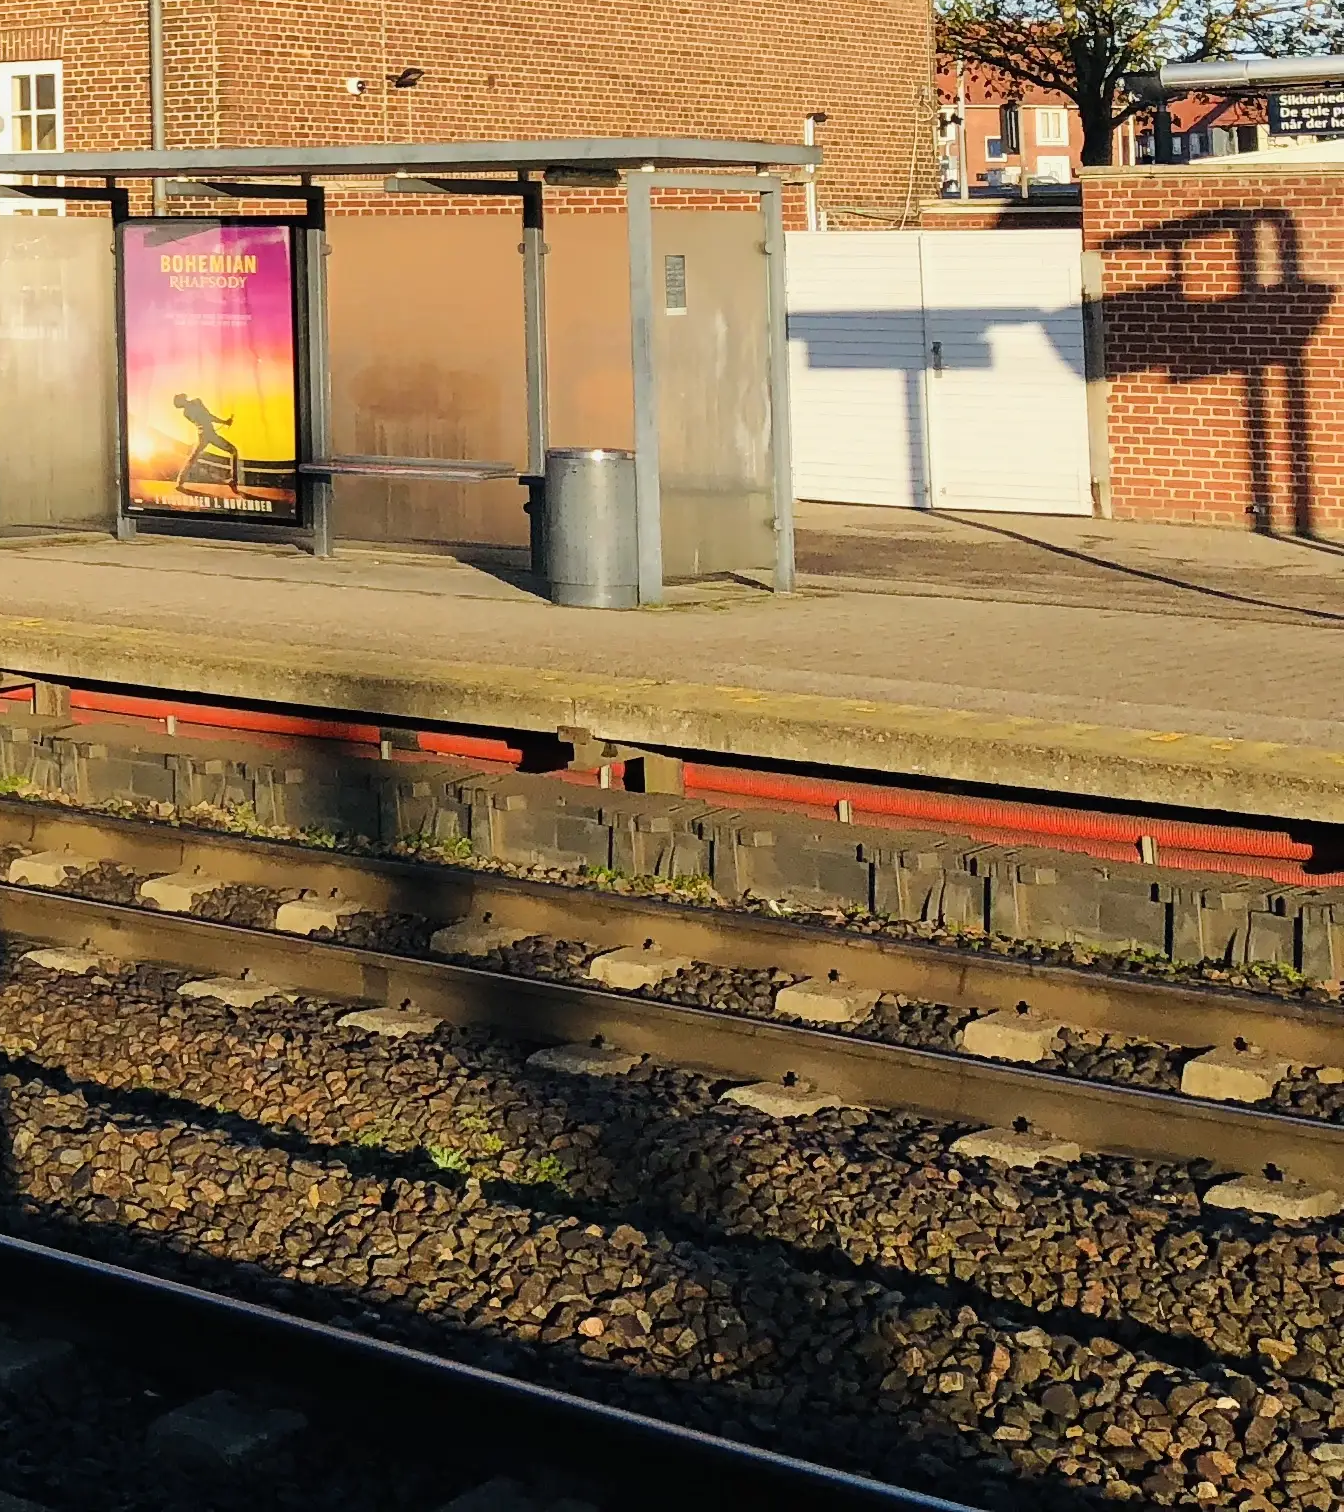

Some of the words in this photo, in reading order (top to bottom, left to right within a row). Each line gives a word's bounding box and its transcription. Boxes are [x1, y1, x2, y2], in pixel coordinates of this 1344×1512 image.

[1278, 91, 1344, 106] Sikkerhed
[1279, 107, 1298, 118] De
[1301, 105, 1331, 119] gule
[1280, 118, 1303, 130] når
[1306, 118, 1328, 129] der
[160, 254, 257, 274] BOHEMIAN
[169, 275, 248, 291] RHAPSODY
[223, 498, 273, 513] NOVEMBER
